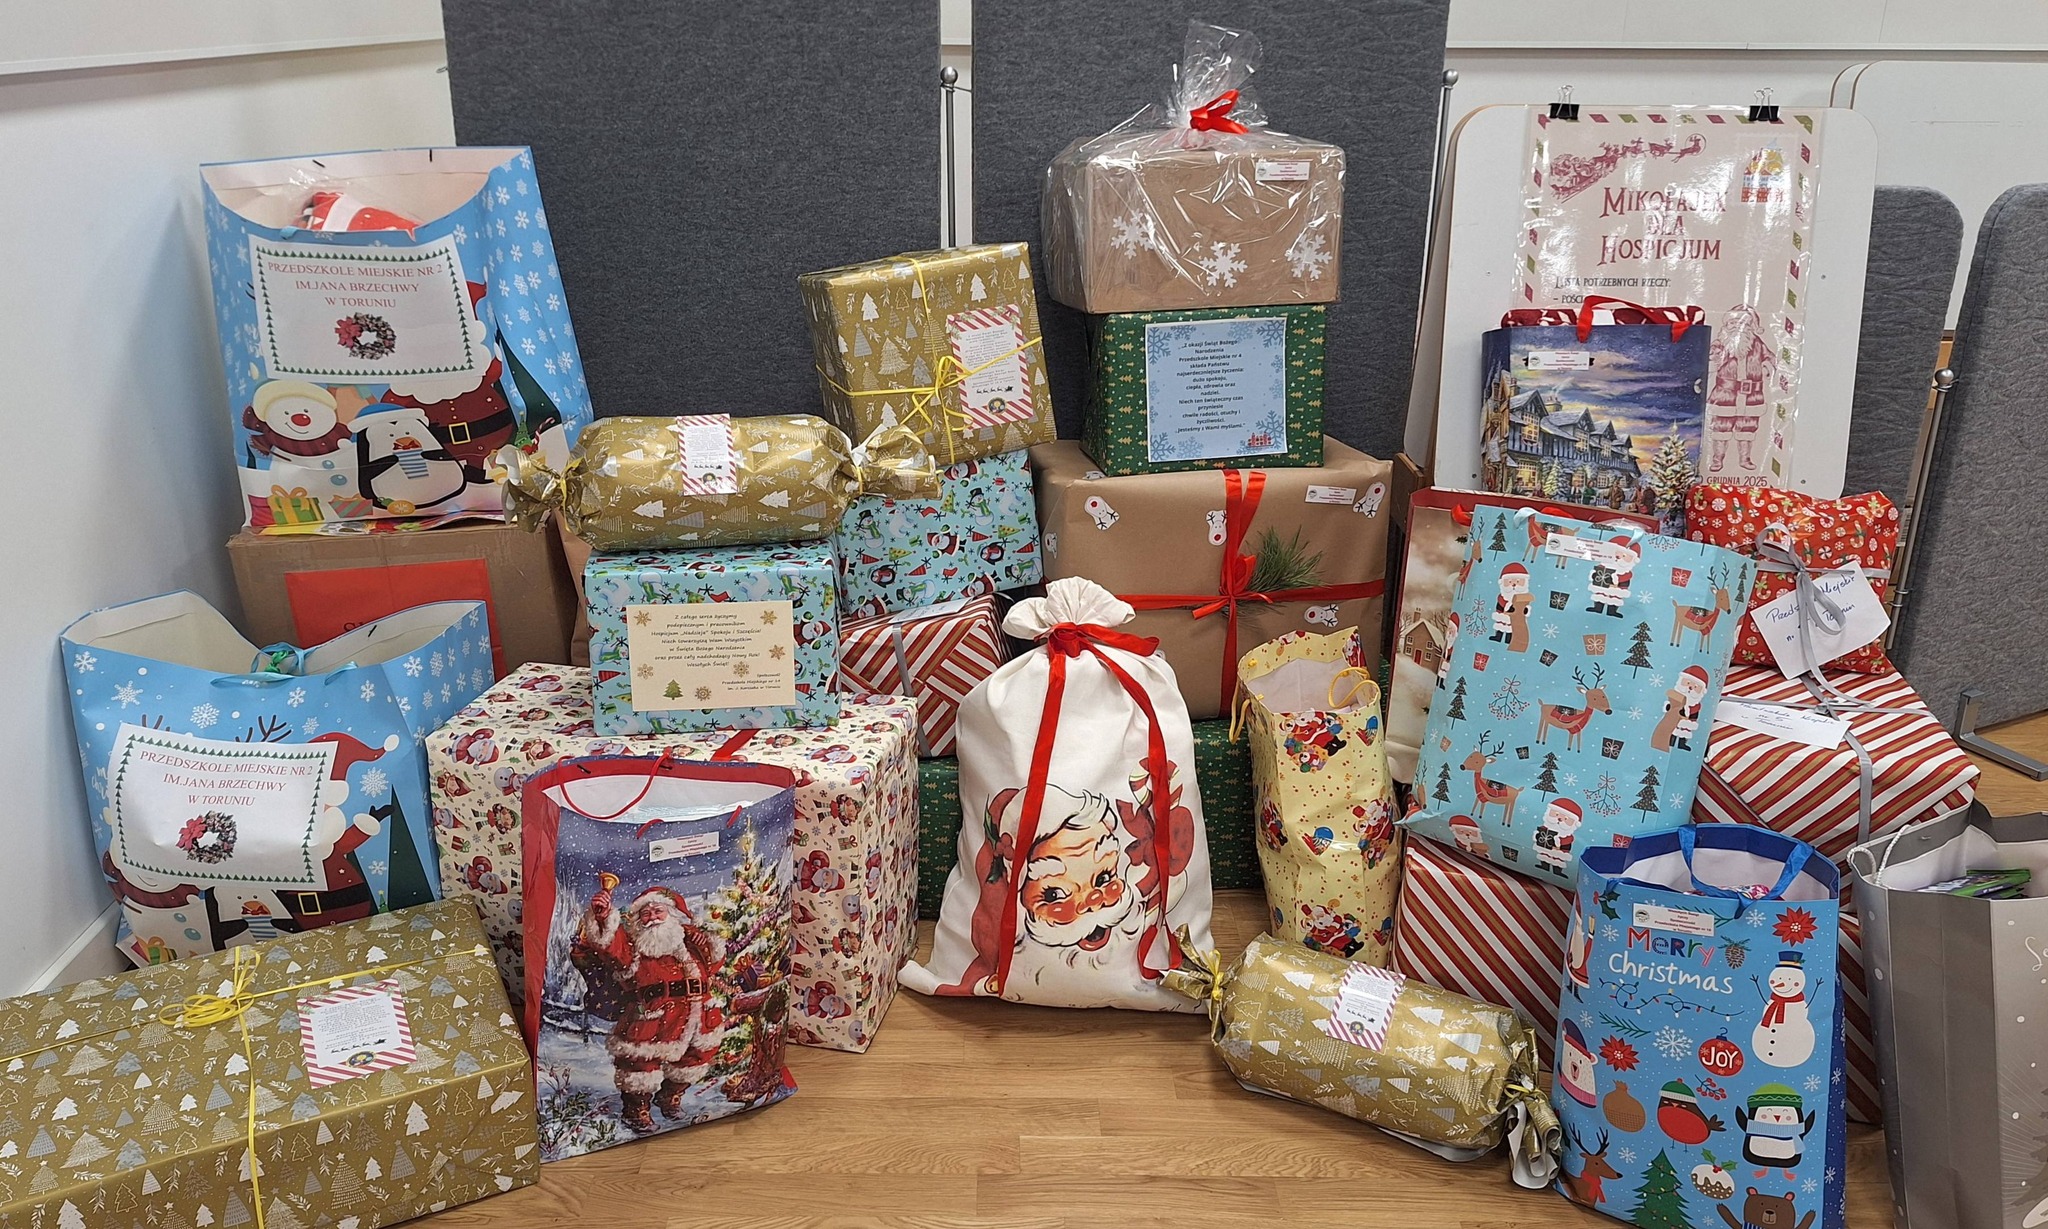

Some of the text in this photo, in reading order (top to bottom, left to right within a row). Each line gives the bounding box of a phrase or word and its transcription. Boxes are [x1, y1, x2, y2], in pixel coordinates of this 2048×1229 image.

[1647, 215, 1684, 236] DLA
[1596, 235, 1722, 266] HOSPICJUM
[267, 262, 442, 278] PRZEDSZKOLE MIEJSKIE NR 2
[350, 283, 420, 293] BRZECHWY
[1583, 278, 1638, 287] POTRZEBNYCH
[324, 297, 397, 308] W TORUNIU
[1562, 294, 1584, 304] POŚCI
[1706, 476, 1740, 485] GRUDNIA
[1744, 476, 1768, 487] 2025
[139, 750, 313, 776] PRZEDSZKOLE MIEJSKIE NR 2
[218, 780, 287, 792] BRZECHWY
[188, 795, 256, 806] W TORUNIU
[1608, 950, 1733, 994] Christmas
